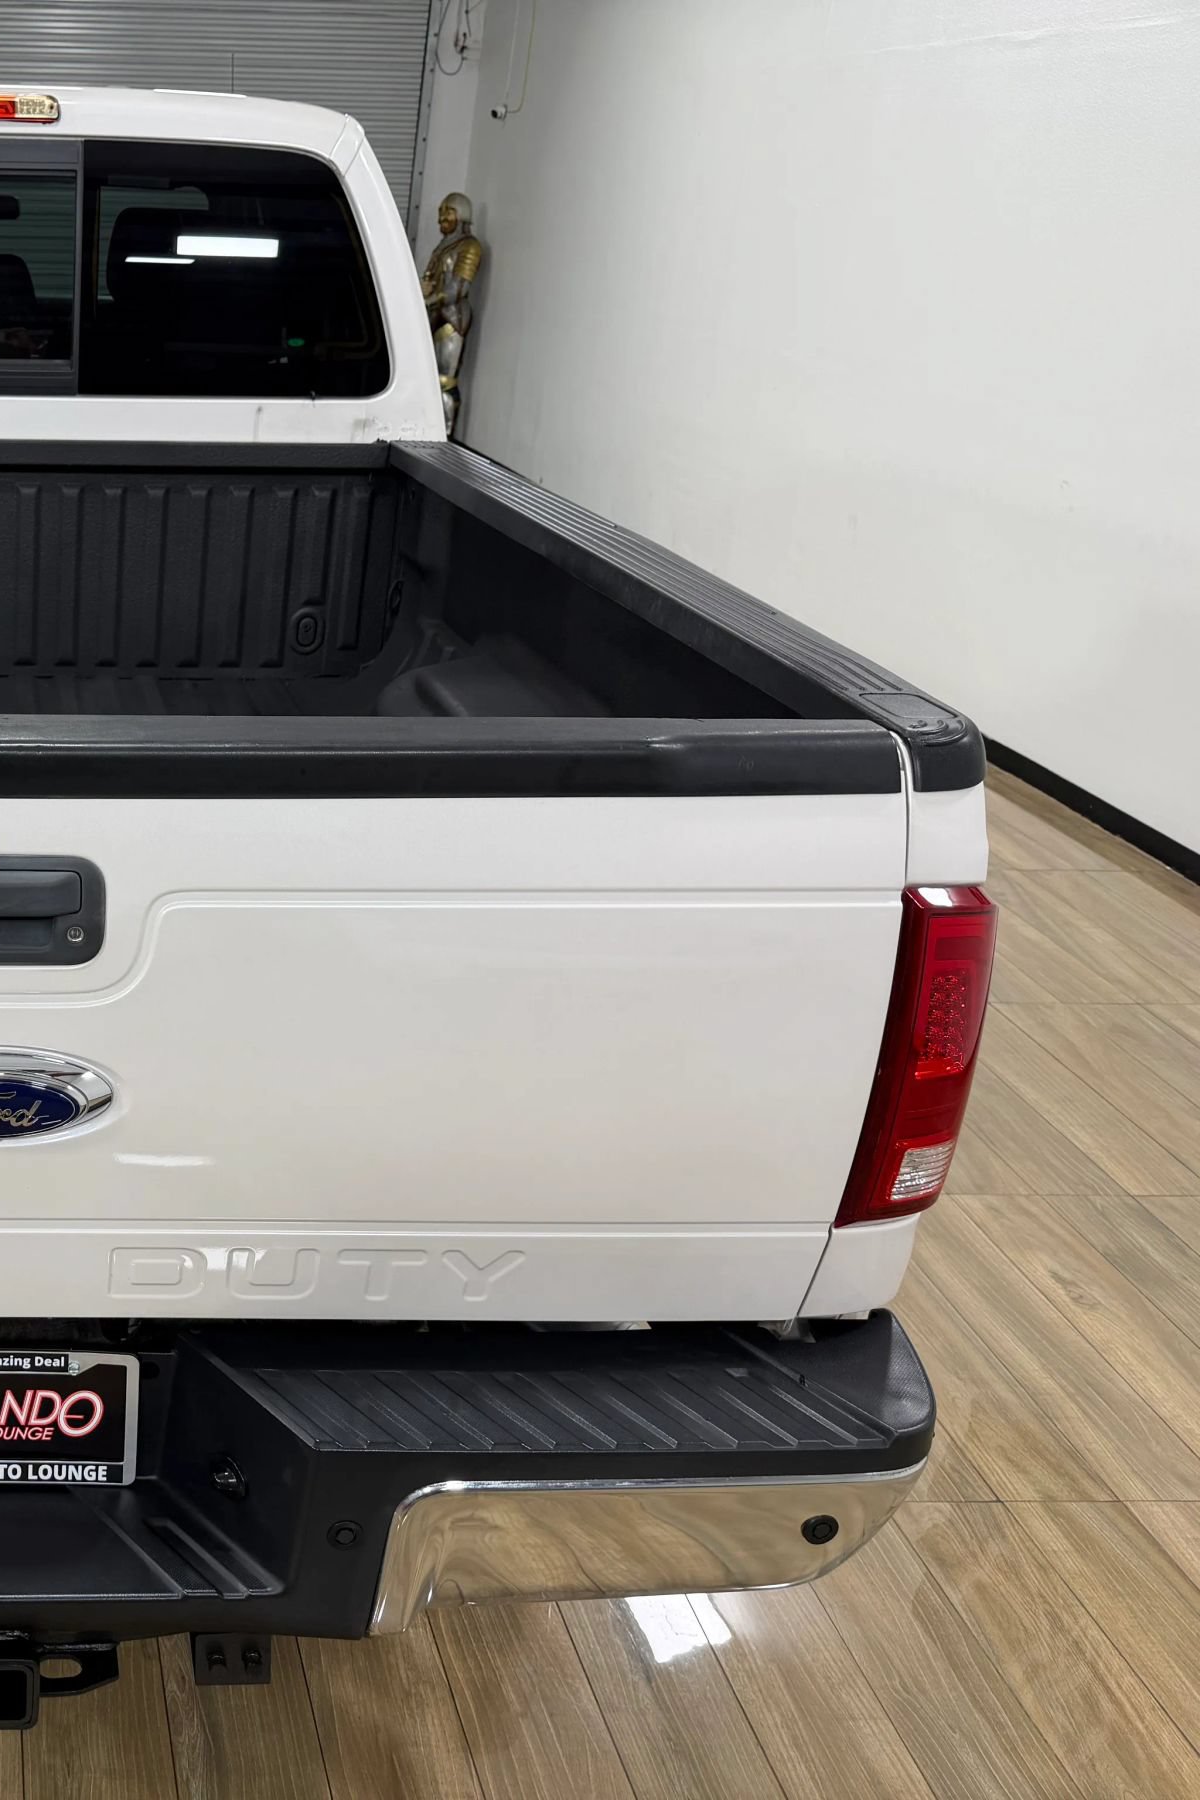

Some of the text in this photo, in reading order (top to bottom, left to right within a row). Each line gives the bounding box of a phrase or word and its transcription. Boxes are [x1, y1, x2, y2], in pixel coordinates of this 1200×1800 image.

[108, 1246, 526, 1301] DUTY
[34, 1356, 65, 1368] Deal
[27, 1464, 108, 1482] LOUNGE
